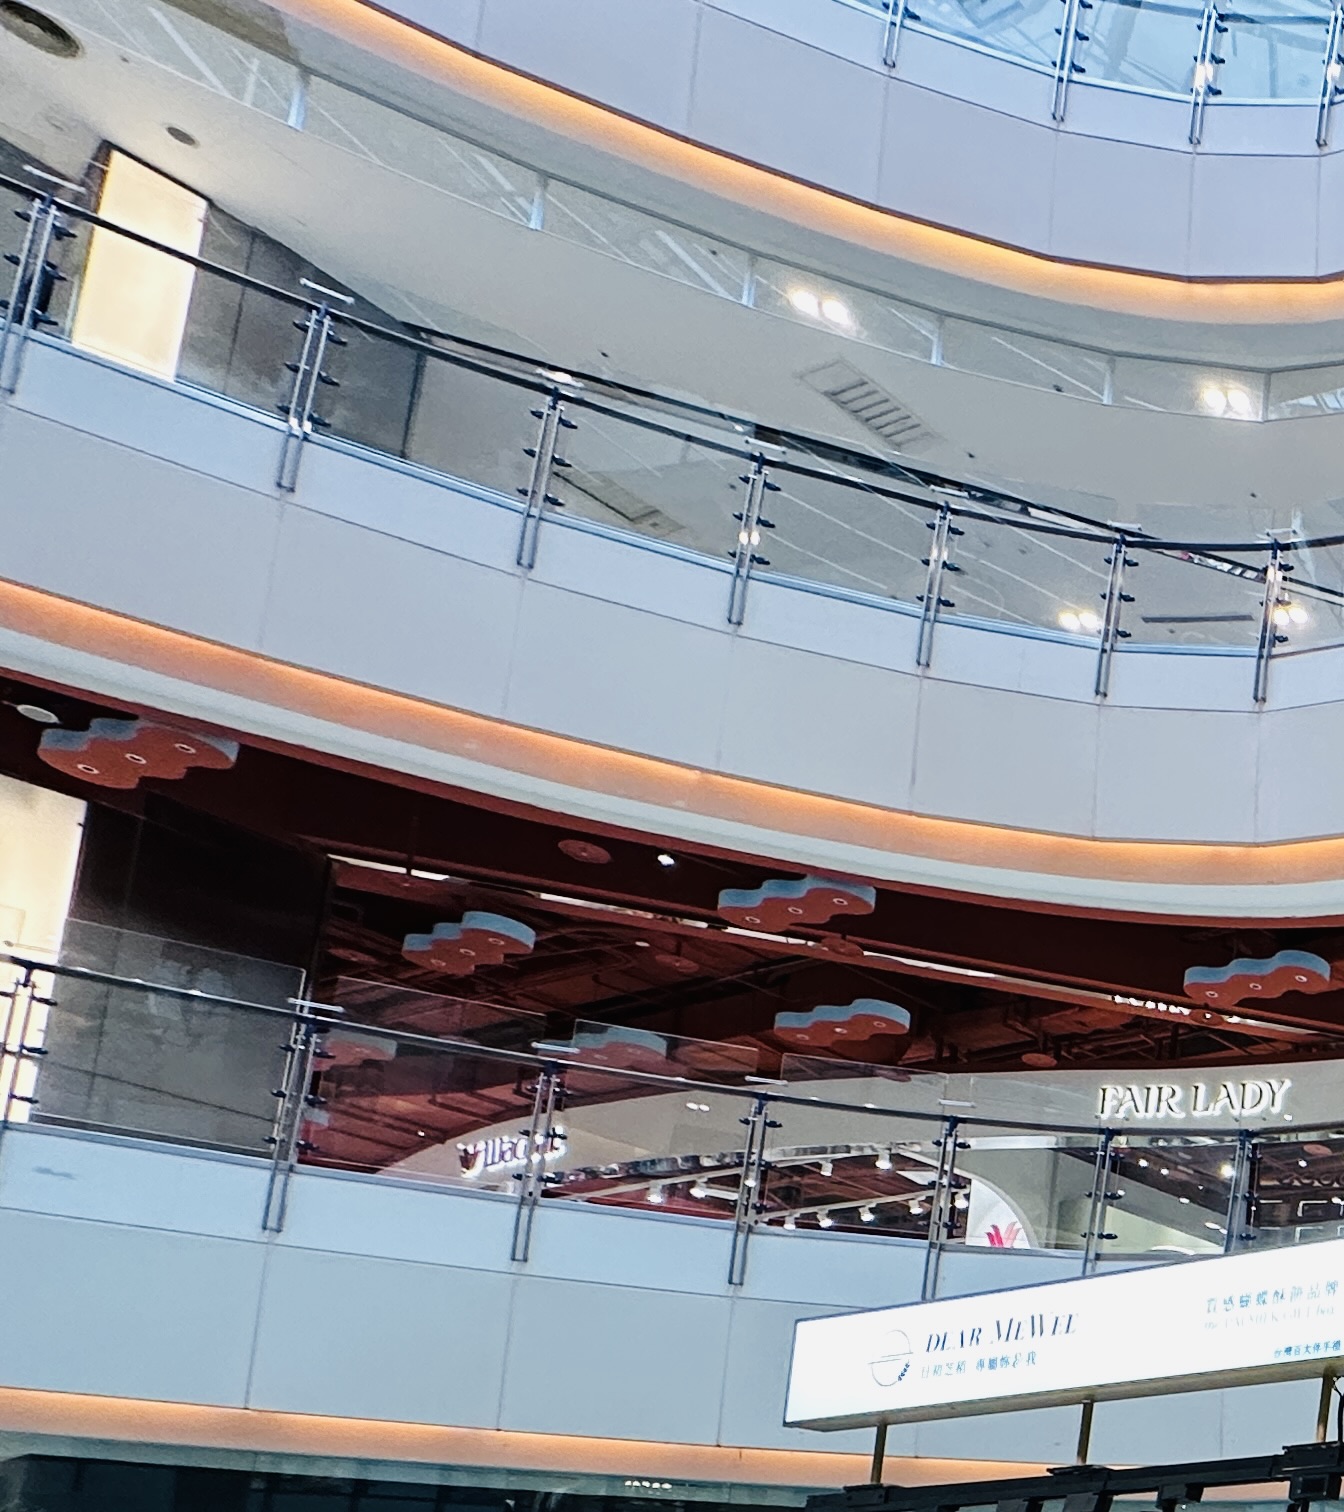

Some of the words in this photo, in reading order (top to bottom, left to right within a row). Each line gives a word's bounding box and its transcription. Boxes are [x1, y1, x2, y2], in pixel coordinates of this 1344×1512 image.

[1100, 1084, 1184, 1118] FAIR
[1192, 1079, 1291, 1117] LADY
[926, 1326, 982, 1353] DEAR
